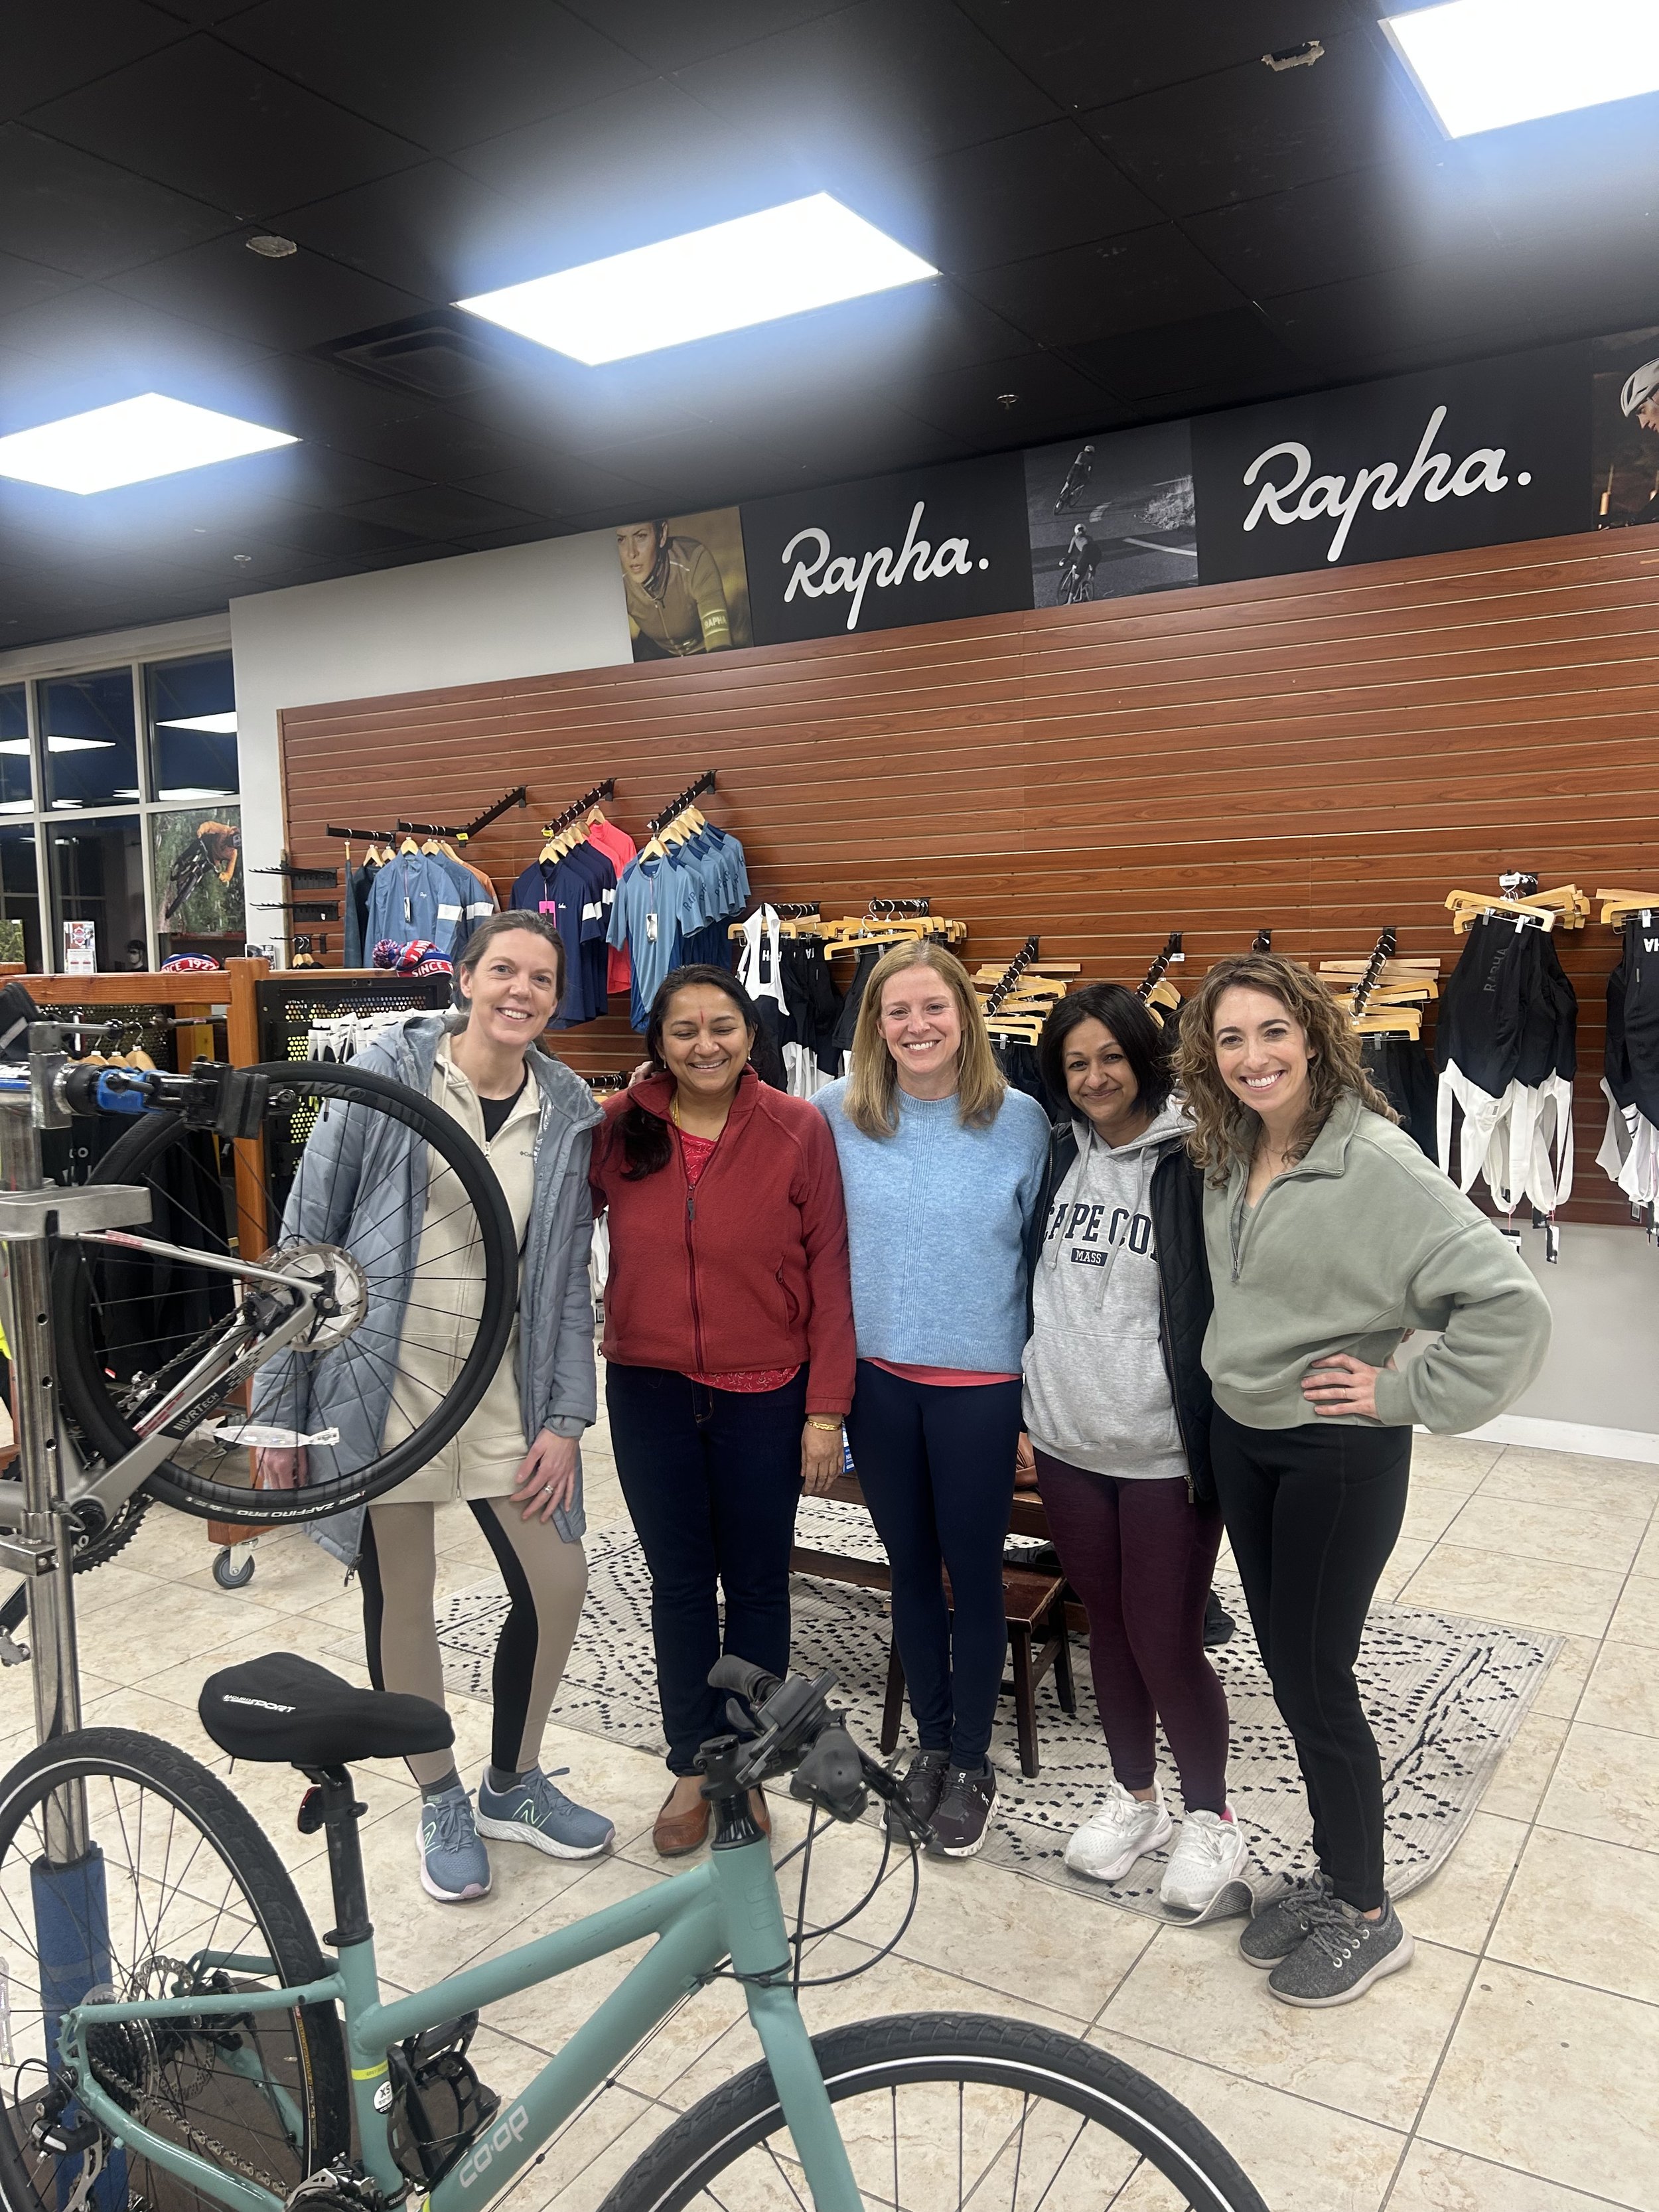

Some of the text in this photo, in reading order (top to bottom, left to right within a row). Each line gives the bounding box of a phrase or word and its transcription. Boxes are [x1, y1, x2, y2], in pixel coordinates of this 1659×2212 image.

[411, 962, 445, 977] SINCE
[297, 1081, 367, 1100] OVAL
[1044, 1203, 1158, 1261] APE CO
[1076, 1250, 1102, 1264] MASS
[271, 1501, 335, 1518] ZAFFIRO
